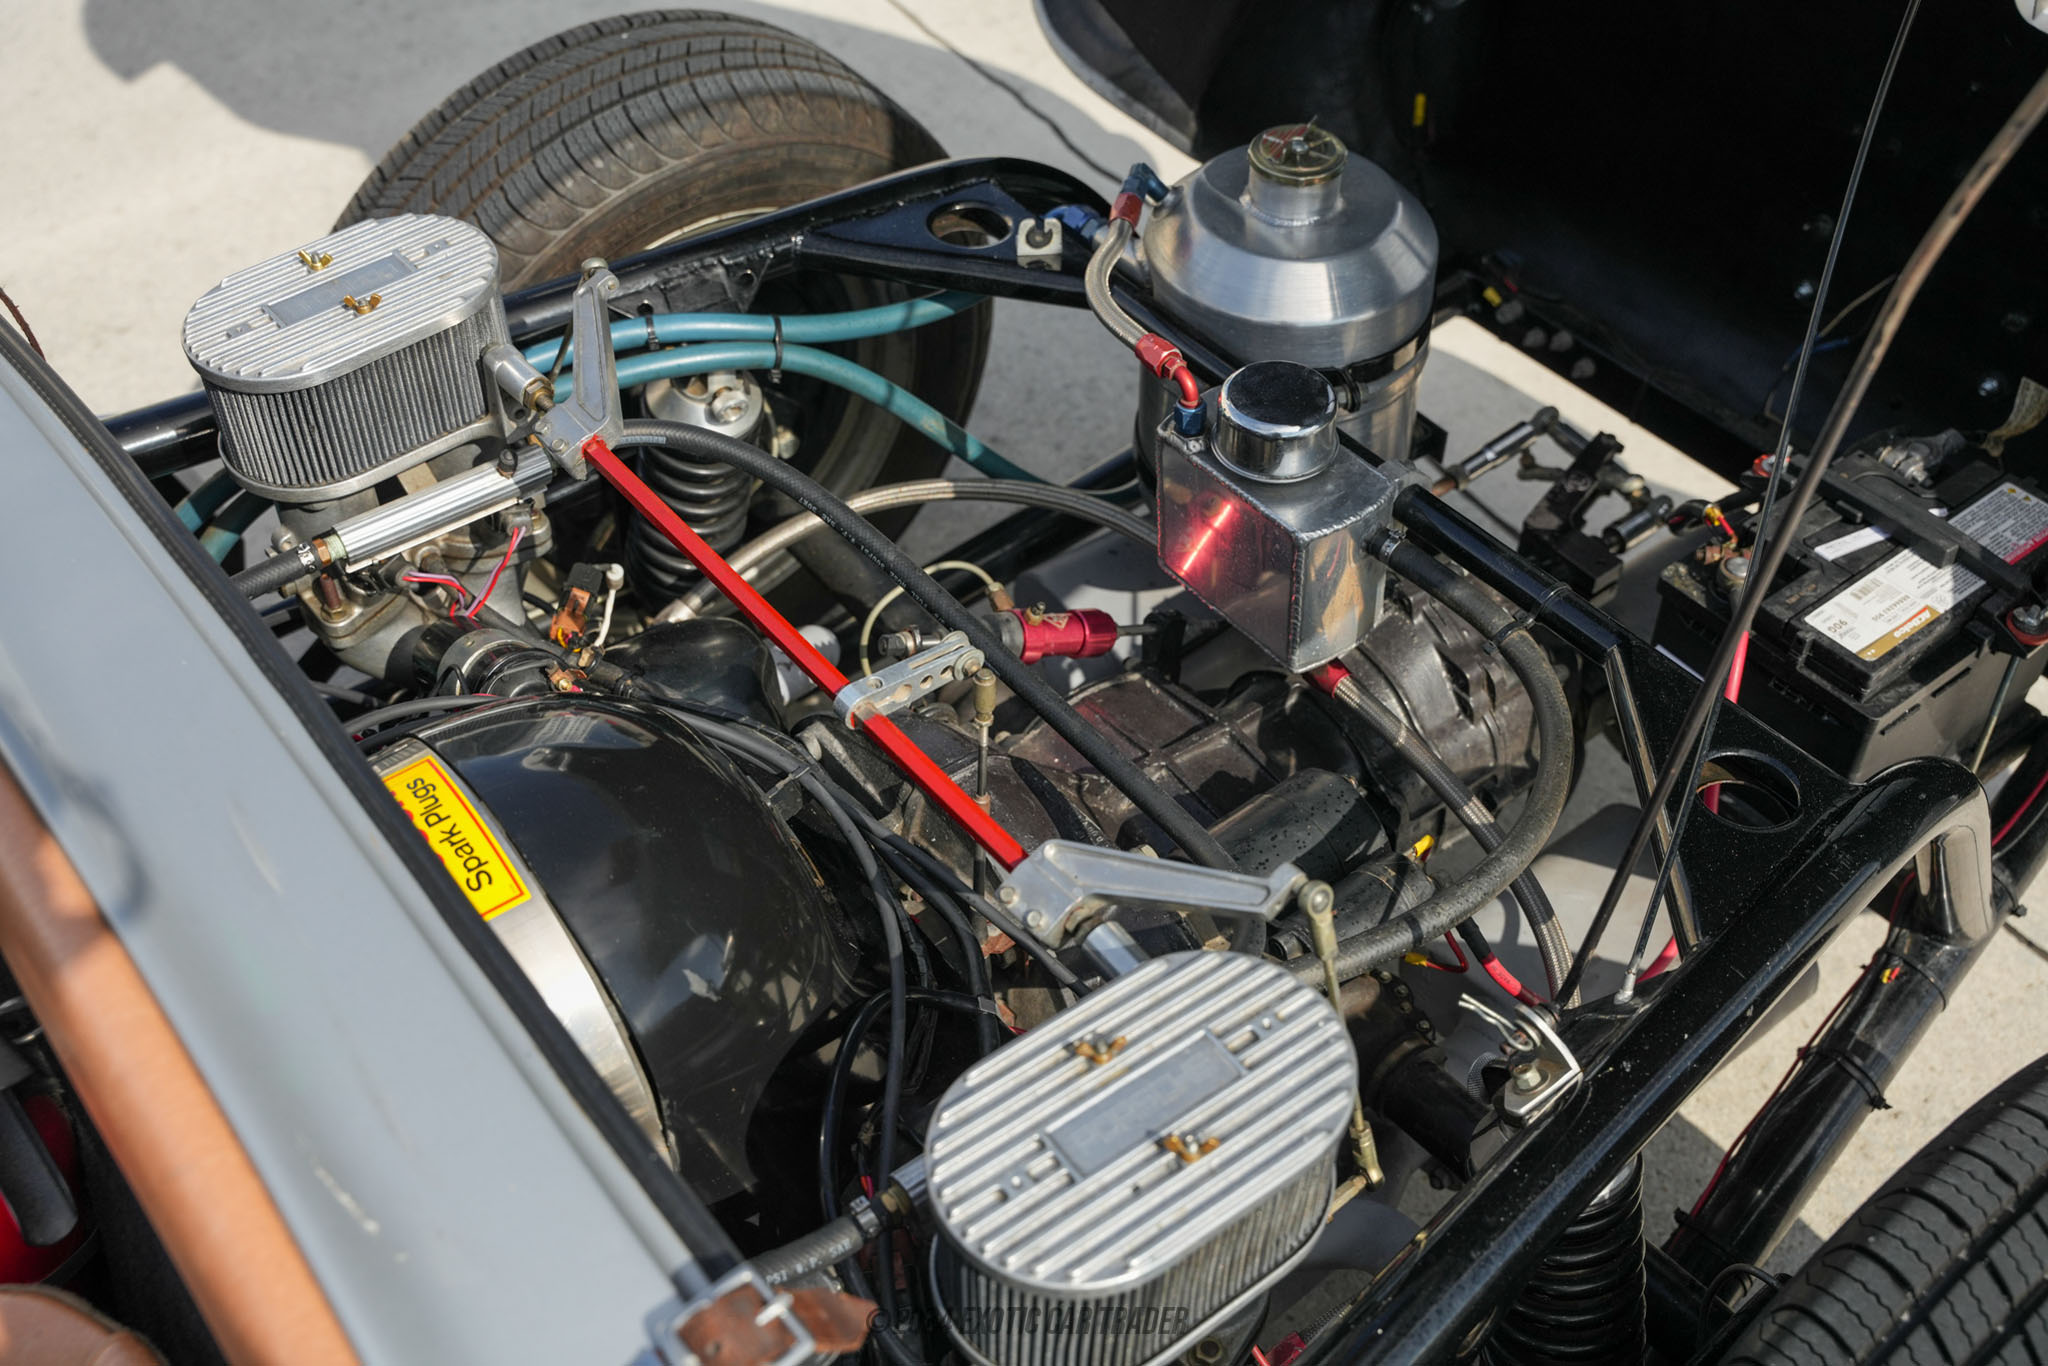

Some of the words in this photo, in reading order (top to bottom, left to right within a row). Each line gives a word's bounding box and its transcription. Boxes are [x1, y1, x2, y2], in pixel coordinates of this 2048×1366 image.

[1893, 609, 1932, 638] ACDelco
[406, 777, 451, 828] Plugs
[439, 823, 493, 892] Spark
